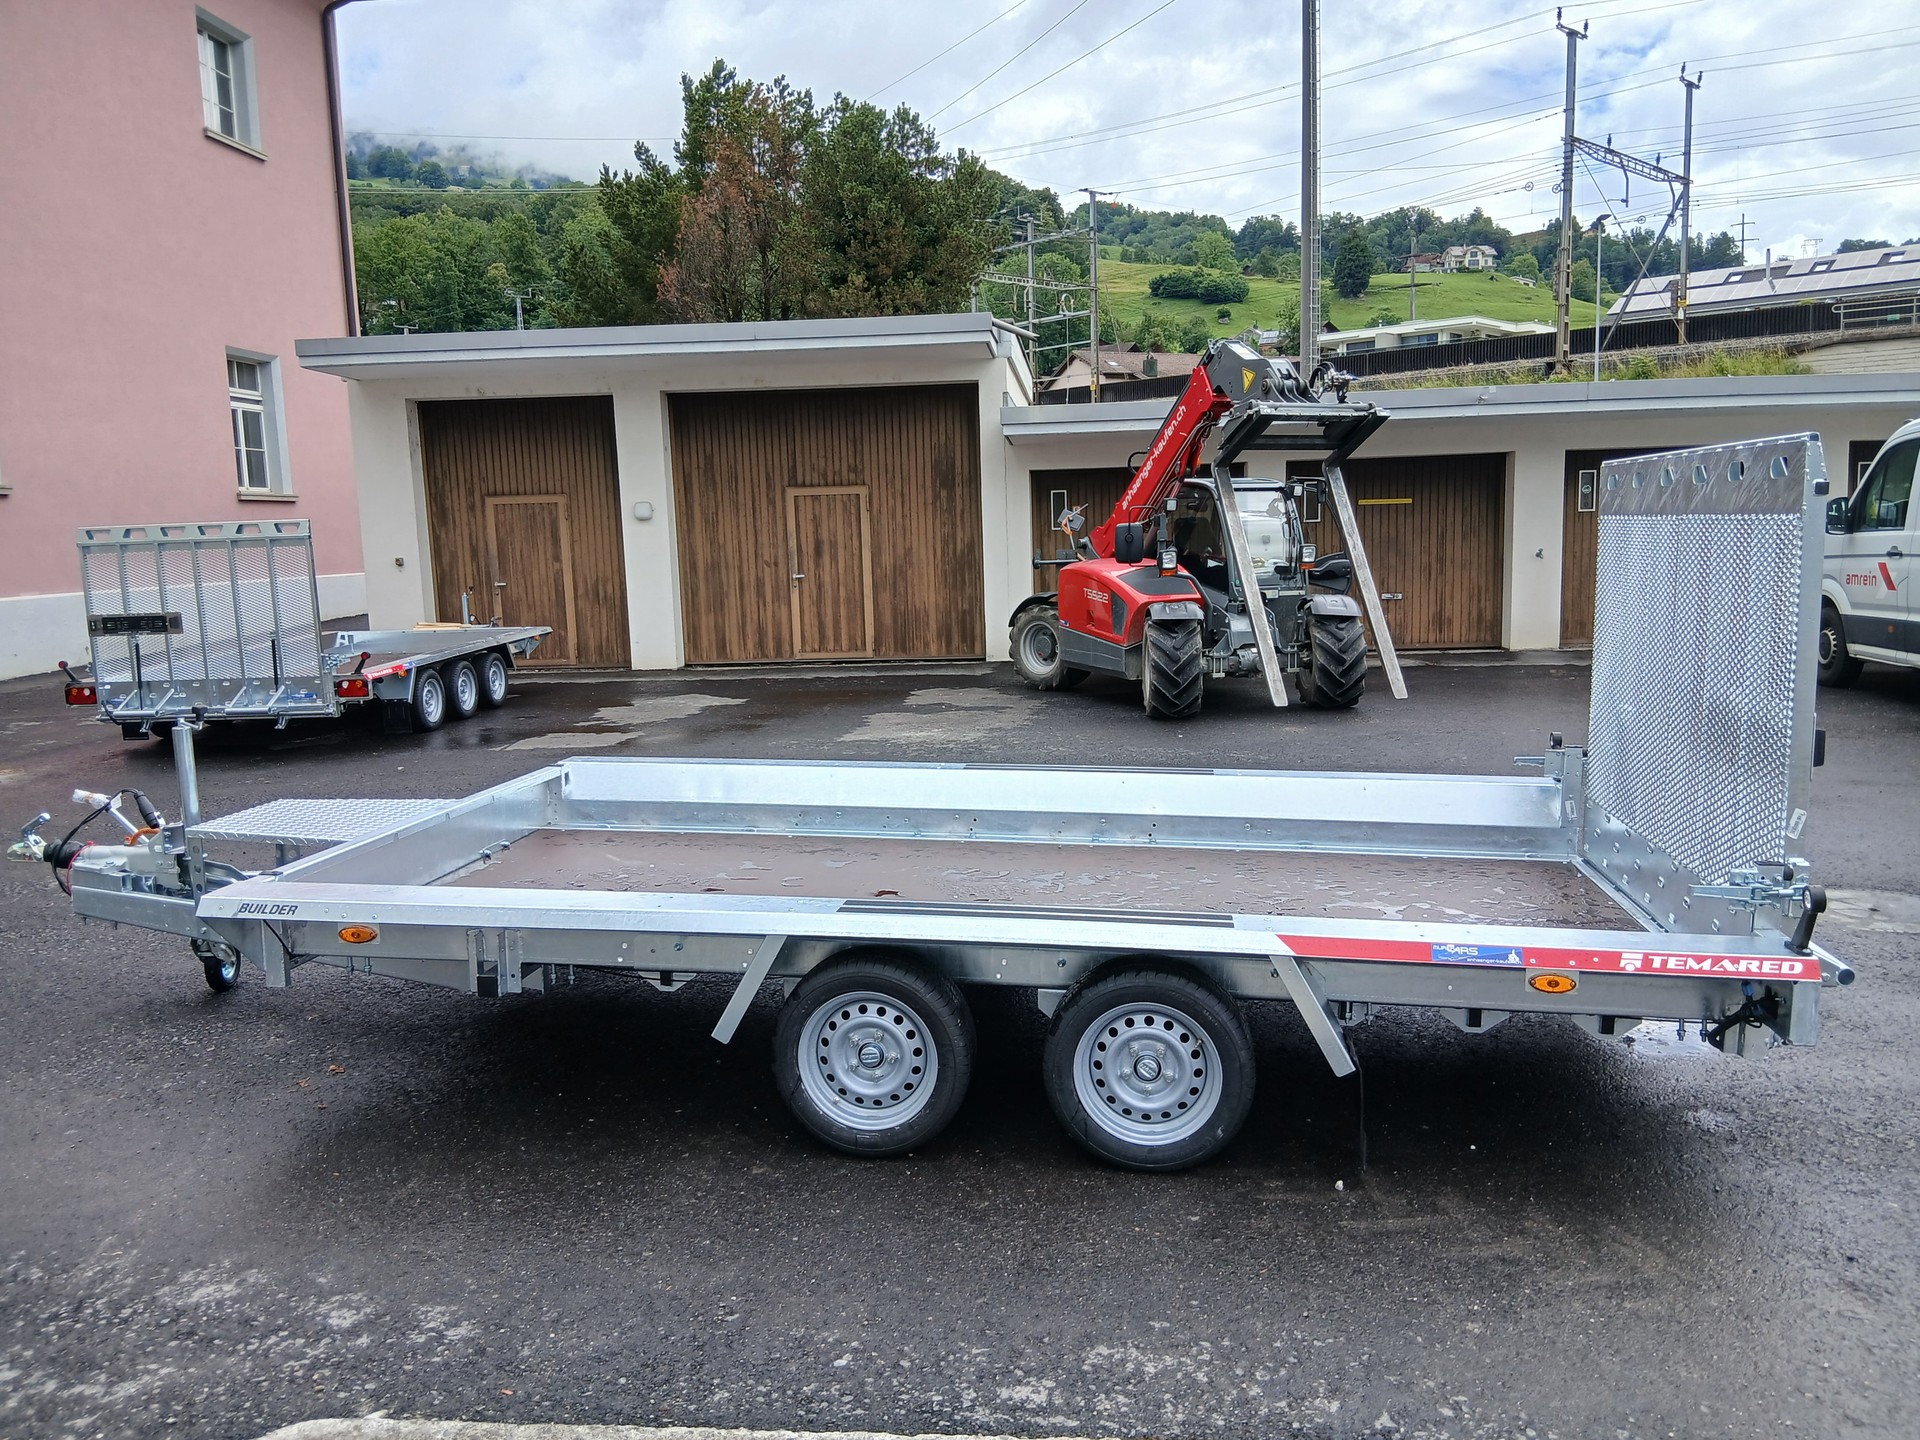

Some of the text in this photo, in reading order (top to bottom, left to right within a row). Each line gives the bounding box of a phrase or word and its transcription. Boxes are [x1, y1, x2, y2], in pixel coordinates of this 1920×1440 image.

[1121, 404, 1187, 510] anhaenger-kaufen.ch
[1845, 571, 1877, 587] amrein
[238, 902, 299, 916] BUILDER
[1648, 955, 1804, 974] TEMARED
